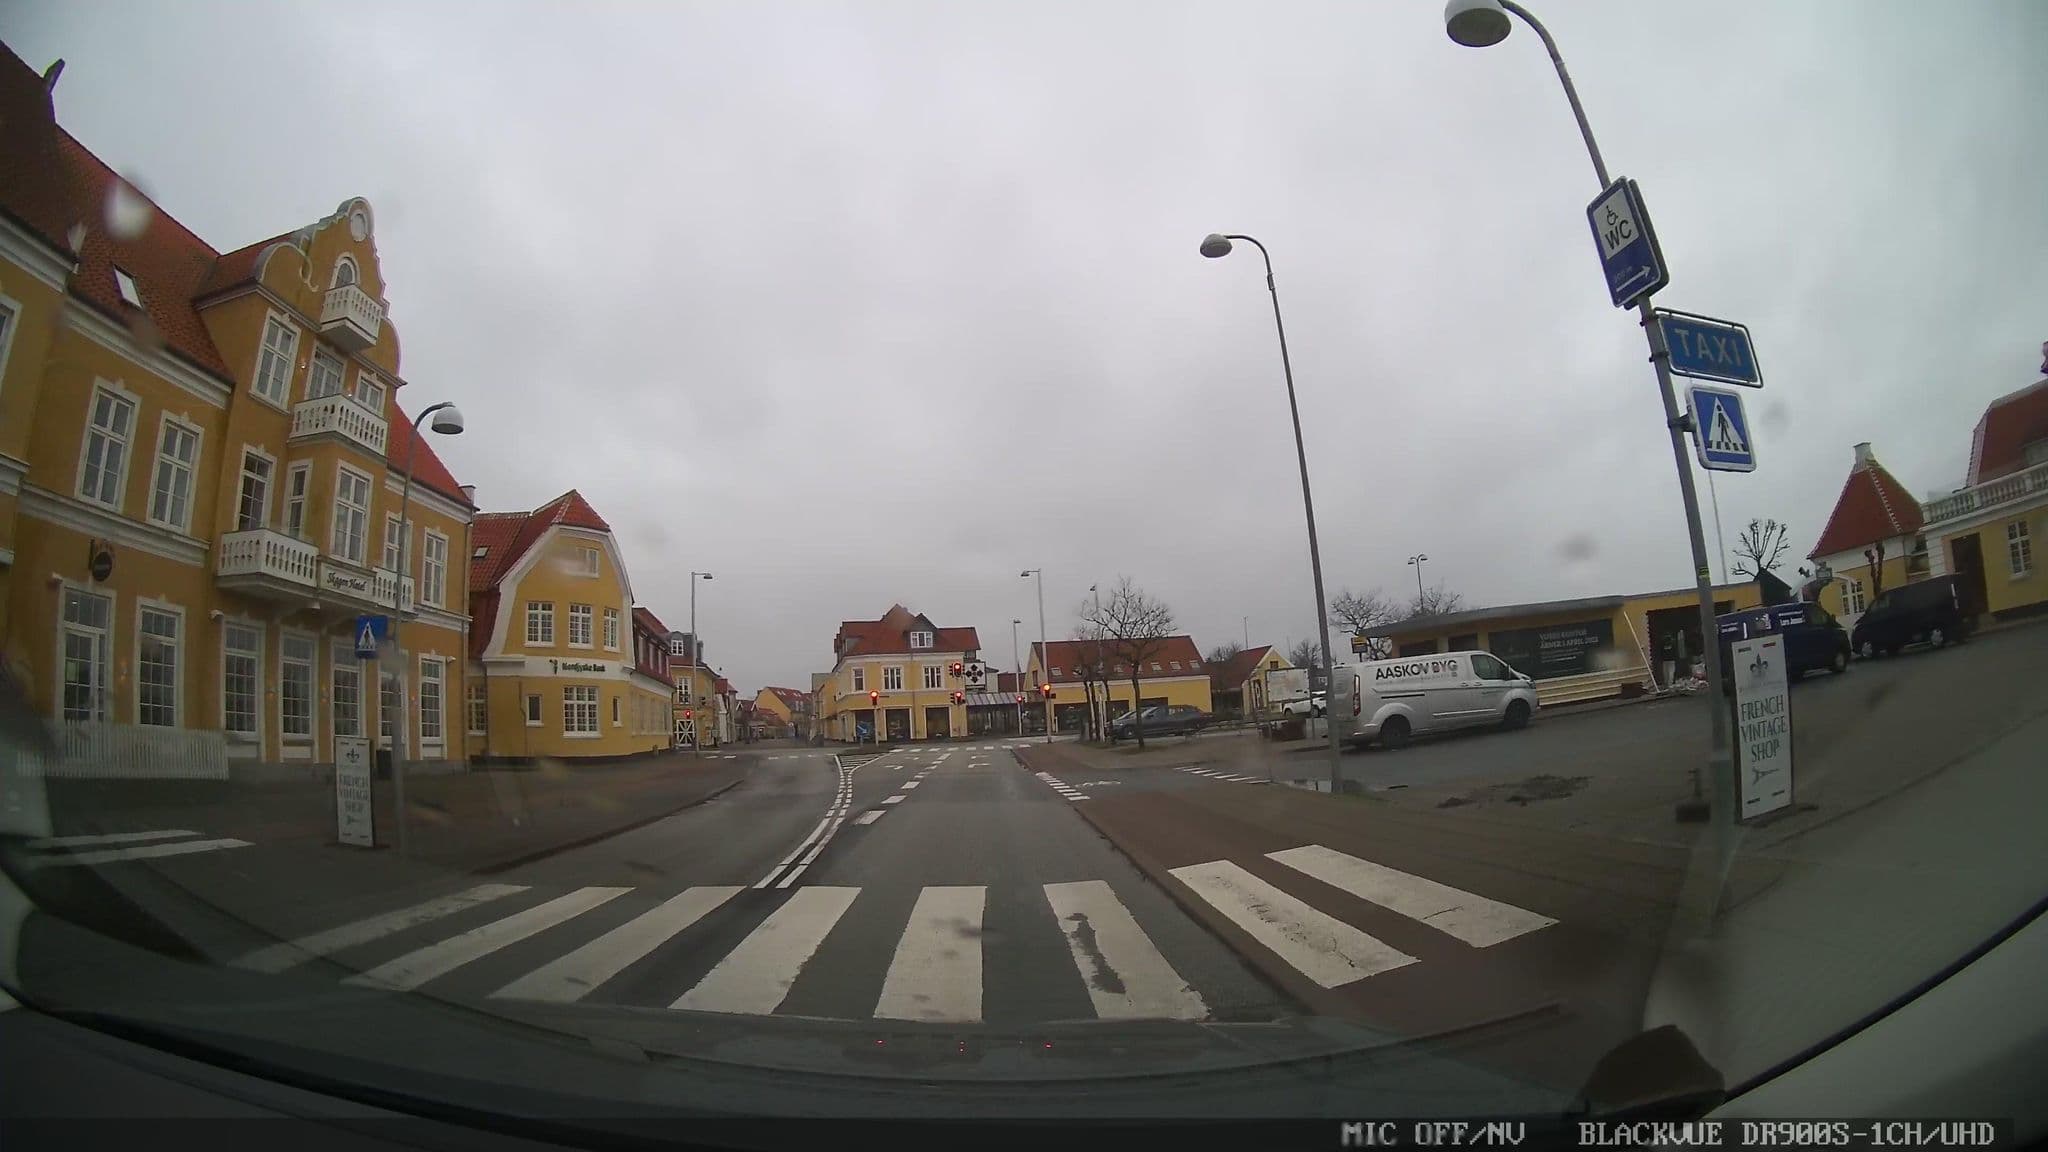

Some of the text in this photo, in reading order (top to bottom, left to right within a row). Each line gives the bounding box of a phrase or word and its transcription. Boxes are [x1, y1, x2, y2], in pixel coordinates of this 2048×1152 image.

[1605, 220, 1632, 250] WC
[1674, 328, 1742, 367] TAXI
[1376, 662, 1429, 680] AASKOV
[1432, 660, 1458, 674] BYG
[1741, 695, 1785, 721] FRENCH
[1741, 716, 1788, 743] VINTAGE
[1751, 739, 1780, 762] SHOP
